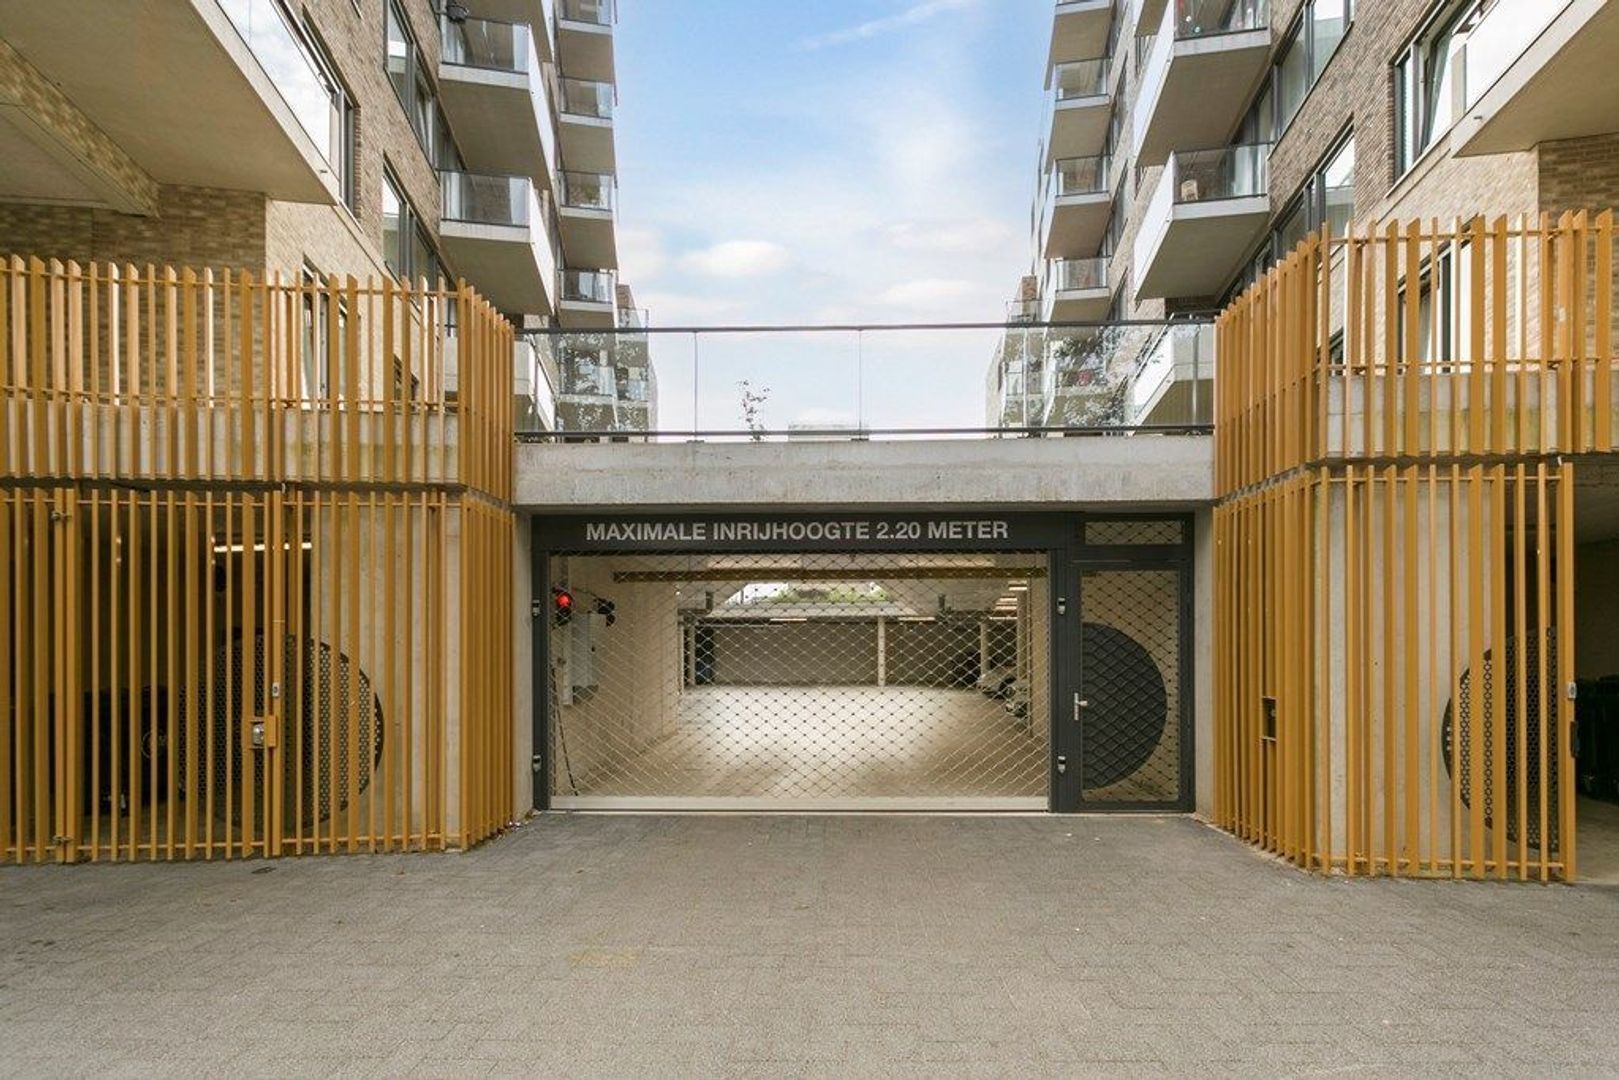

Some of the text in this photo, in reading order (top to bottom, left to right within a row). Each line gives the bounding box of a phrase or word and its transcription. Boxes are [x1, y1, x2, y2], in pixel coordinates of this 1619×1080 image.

[586, 520, 1009, 541] MAXIMALE INRIJHOOGTE 2.20 METER
